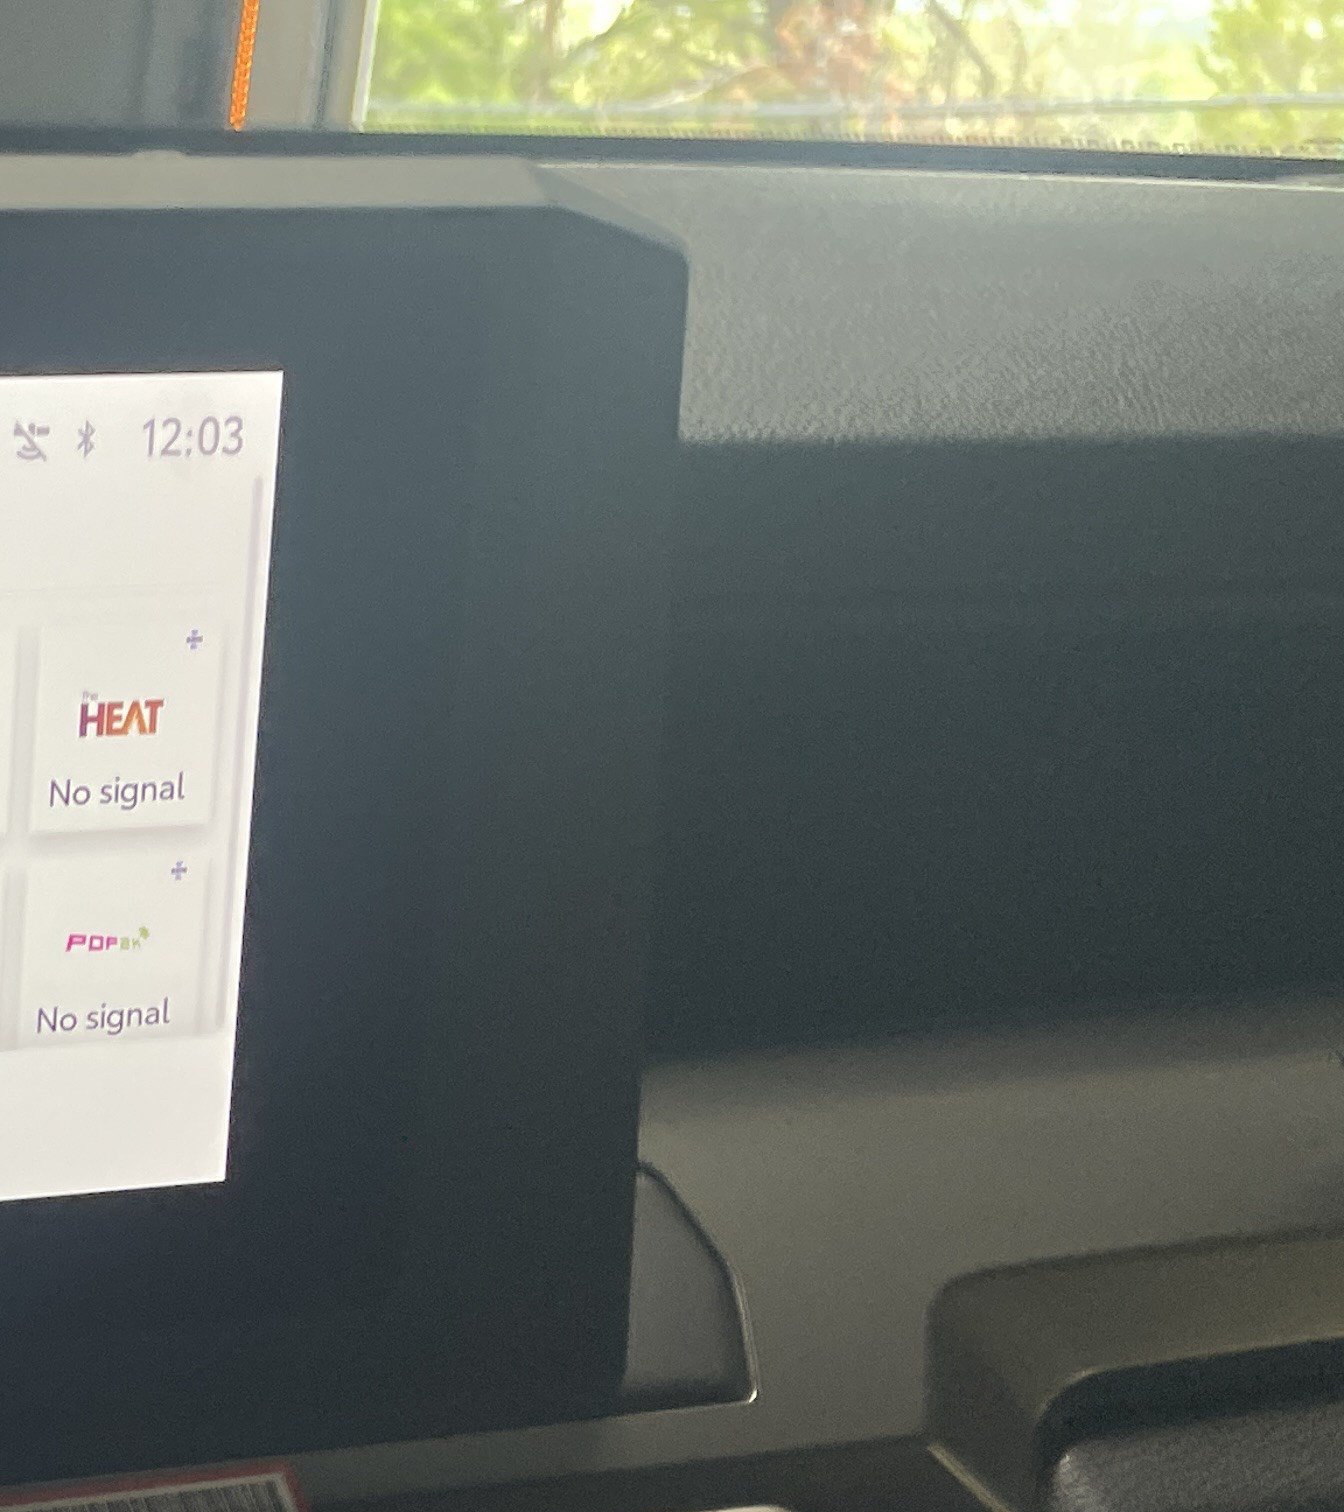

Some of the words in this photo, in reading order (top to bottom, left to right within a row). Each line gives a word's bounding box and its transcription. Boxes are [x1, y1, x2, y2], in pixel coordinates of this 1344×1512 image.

[142, 415, 244, 458] 12:03
[78, 698, 163, 738] HEAT
[49, 778, 92, 808] No
[99, 771, 185, 811] signal
[36, 1006, 78, 1034] No
[86, 996, 170, 1036] signal
